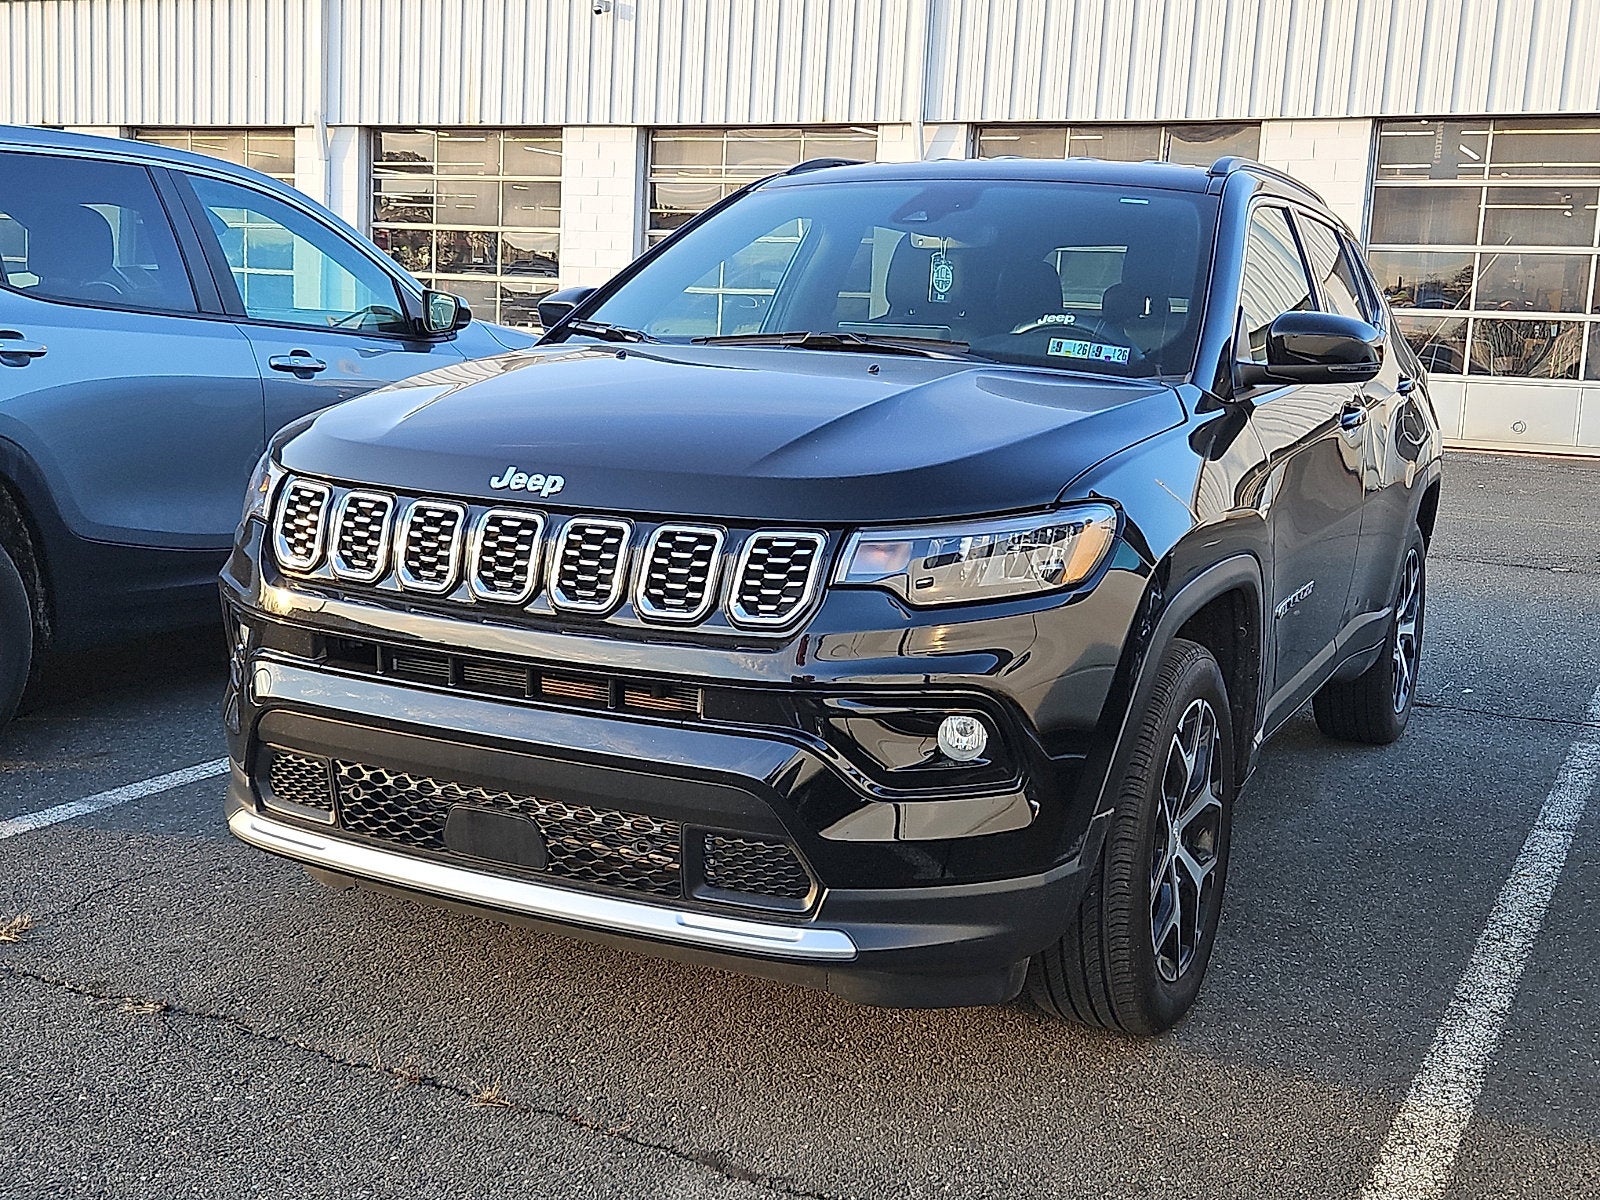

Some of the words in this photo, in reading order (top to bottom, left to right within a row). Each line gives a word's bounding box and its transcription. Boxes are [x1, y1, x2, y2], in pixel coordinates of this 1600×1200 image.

[1037, 314, 1075, 325] Jeep
[1055, 341, 1062, 352] 9
[1077, 343, 1088, 355] 26
[1095, 346, 1102, 357] 9
[1117, 349, 1127, 360] 26
[490, 466, 564, 497] Jeep
